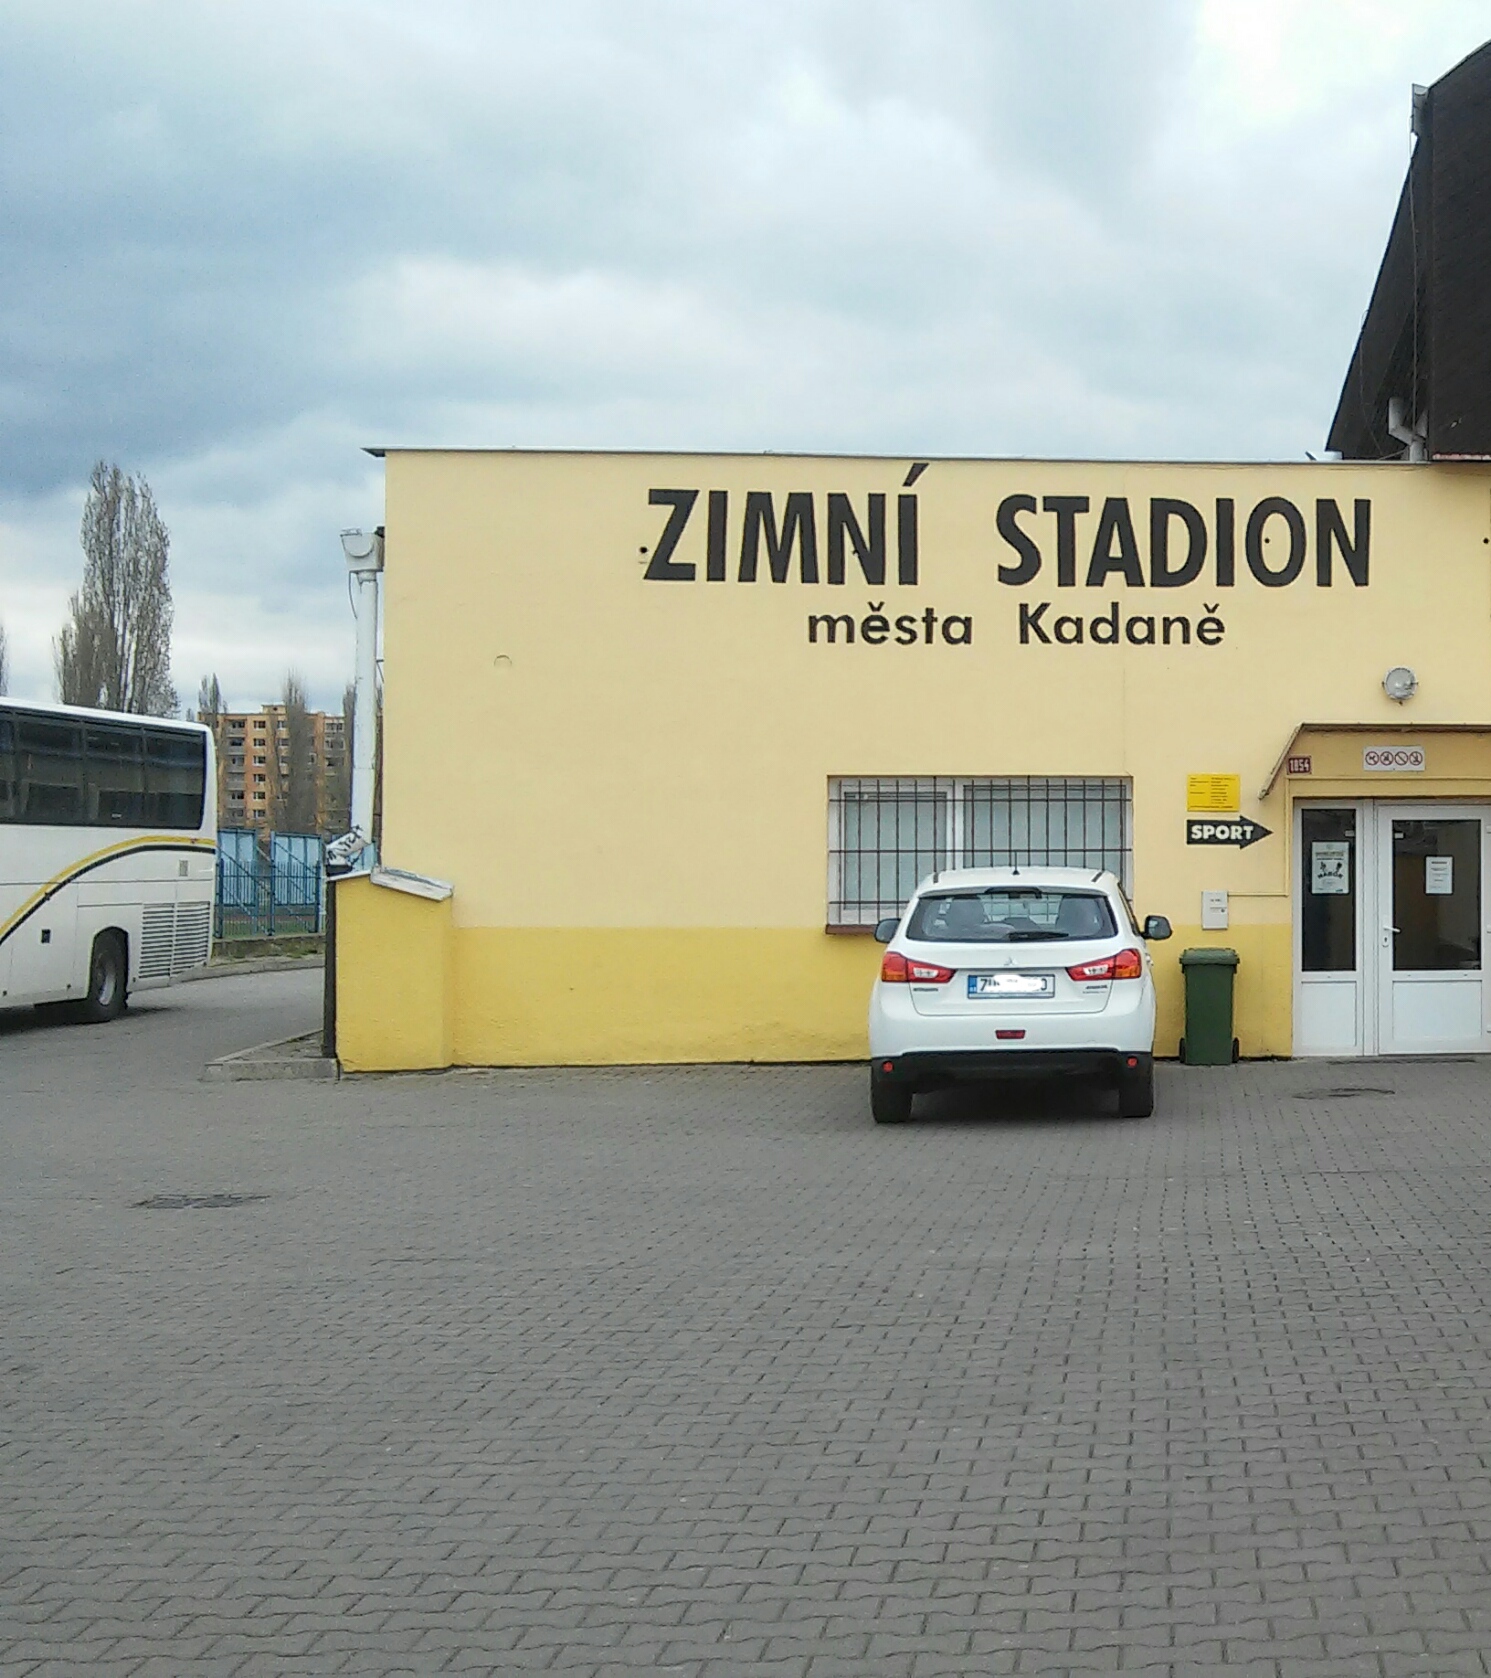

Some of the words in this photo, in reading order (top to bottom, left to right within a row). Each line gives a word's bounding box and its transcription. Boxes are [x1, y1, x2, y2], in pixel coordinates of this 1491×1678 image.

[643, 463, 930, 586] ZIMNÍ
[996, 494, 1372, 588] STADION
[808, 601, 973, 645] města
[1018, 601, 1226, 645] Kadaně
[1191, 824, 1254, 840] SPORT
